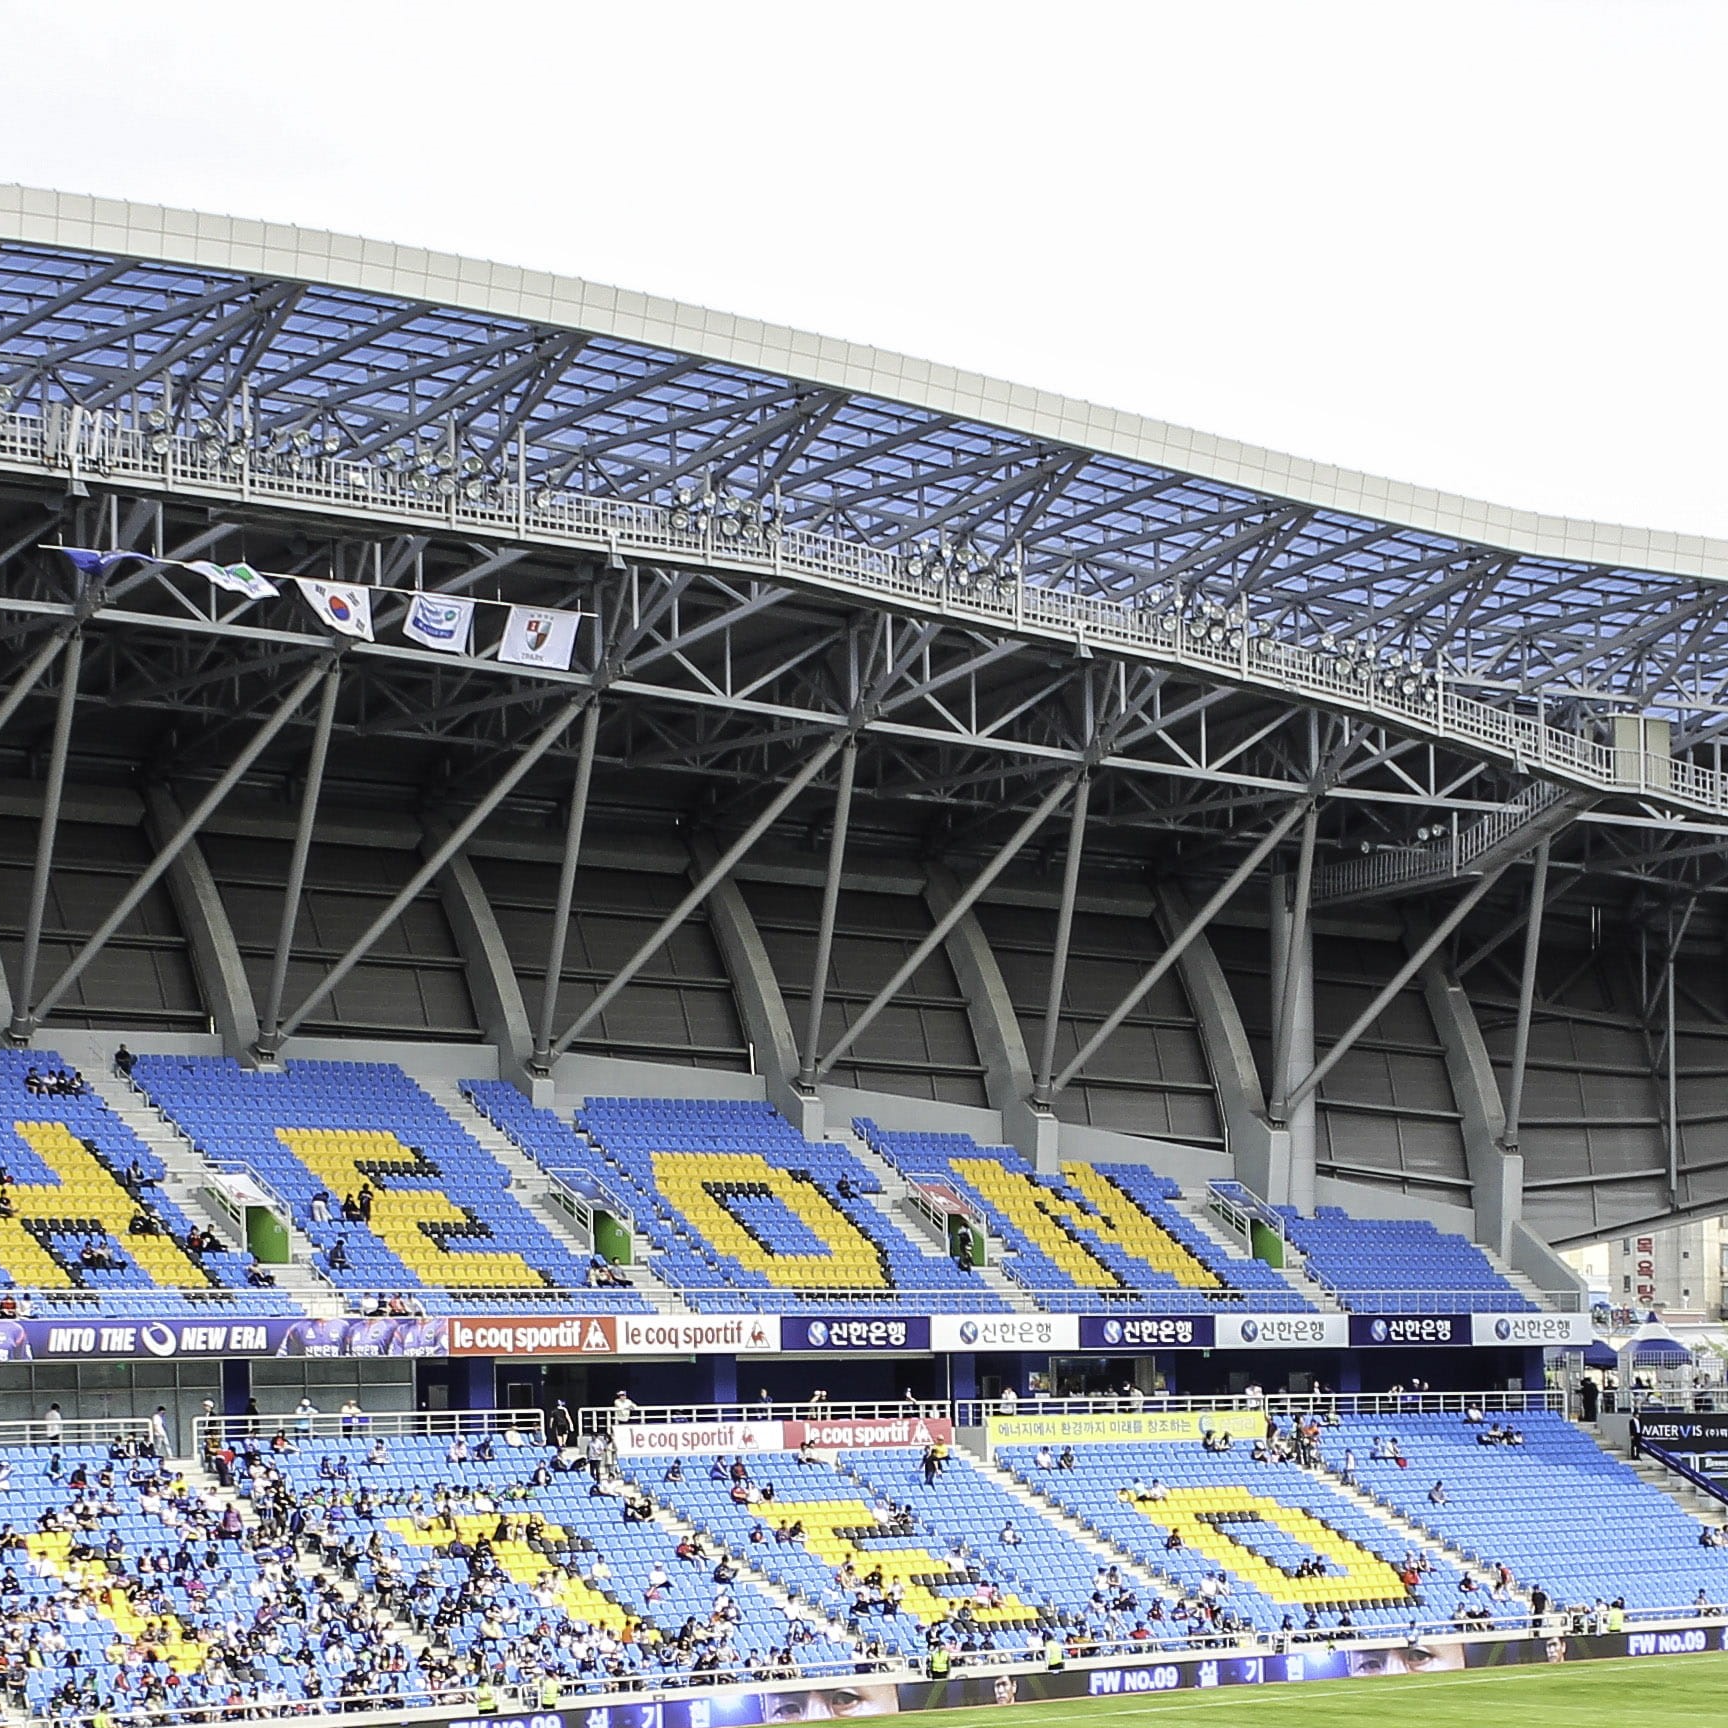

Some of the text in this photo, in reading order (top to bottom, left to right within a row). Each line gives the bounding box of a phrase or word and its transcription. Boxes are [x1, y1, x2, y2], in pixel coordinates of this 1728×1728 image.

[48, 1325, 268, 1353] INTO THE NEW ERA
[454, 1320, 582, 1352] le coq sportif
[625, 1320, 744, 1349] le coq sportif
[828, 1321, 906, 1346] 신한은행
[981, 1321, 1052, 1344] 신한은행
[1122, 1320, 1193, 1343] 신한은행
[1259, 1321, 1325, 1342] 신한은행
[1388, 1319, 1452, 1341] 신한은행
[1512, 1320, 1571, 1340] 신한은행
[630, 1426, 735, 1451] le coq sportif
[804, 1422, 910, 1447] le coq sportif
[998, 1421, 1056, 1436] 에너지에서
[1061, 1420, 1106, 1435] 환경까지
[1110, 1419, 1144, 1434] 미래를
[1629, 1633, 1656, 1656] FW
[1658, 1630, 1706, 1653] NO.09
[1090, 1670, 1121, 1695] FW
[1124, 1666, 1179, 1690] NO.09
[1245, 1657, 1264, 1684] 기
